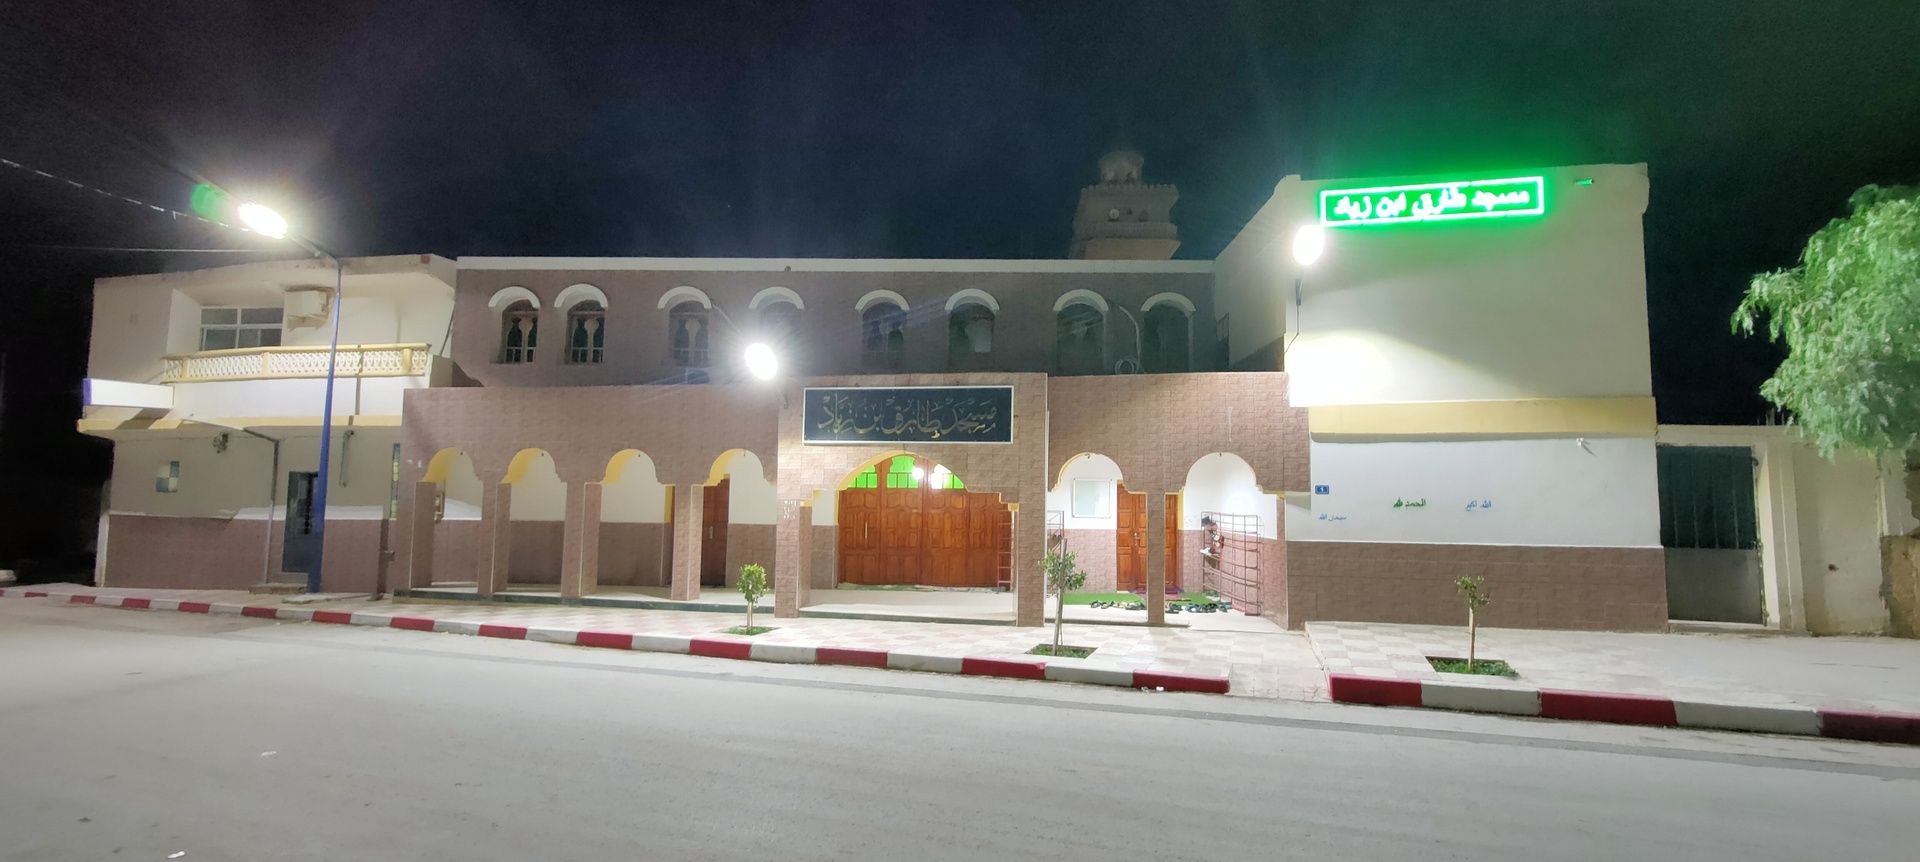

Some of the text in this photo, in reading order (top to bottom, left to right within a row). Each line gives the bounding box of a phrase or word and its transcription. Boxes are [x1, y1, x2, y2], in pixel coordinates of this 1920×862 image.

[1333, 186, 1530, 220] مسجد طارق ابن زياد
[1393, 497, 1426, 509] الحمد لله
[1480, 499, 1492, 509] الله
